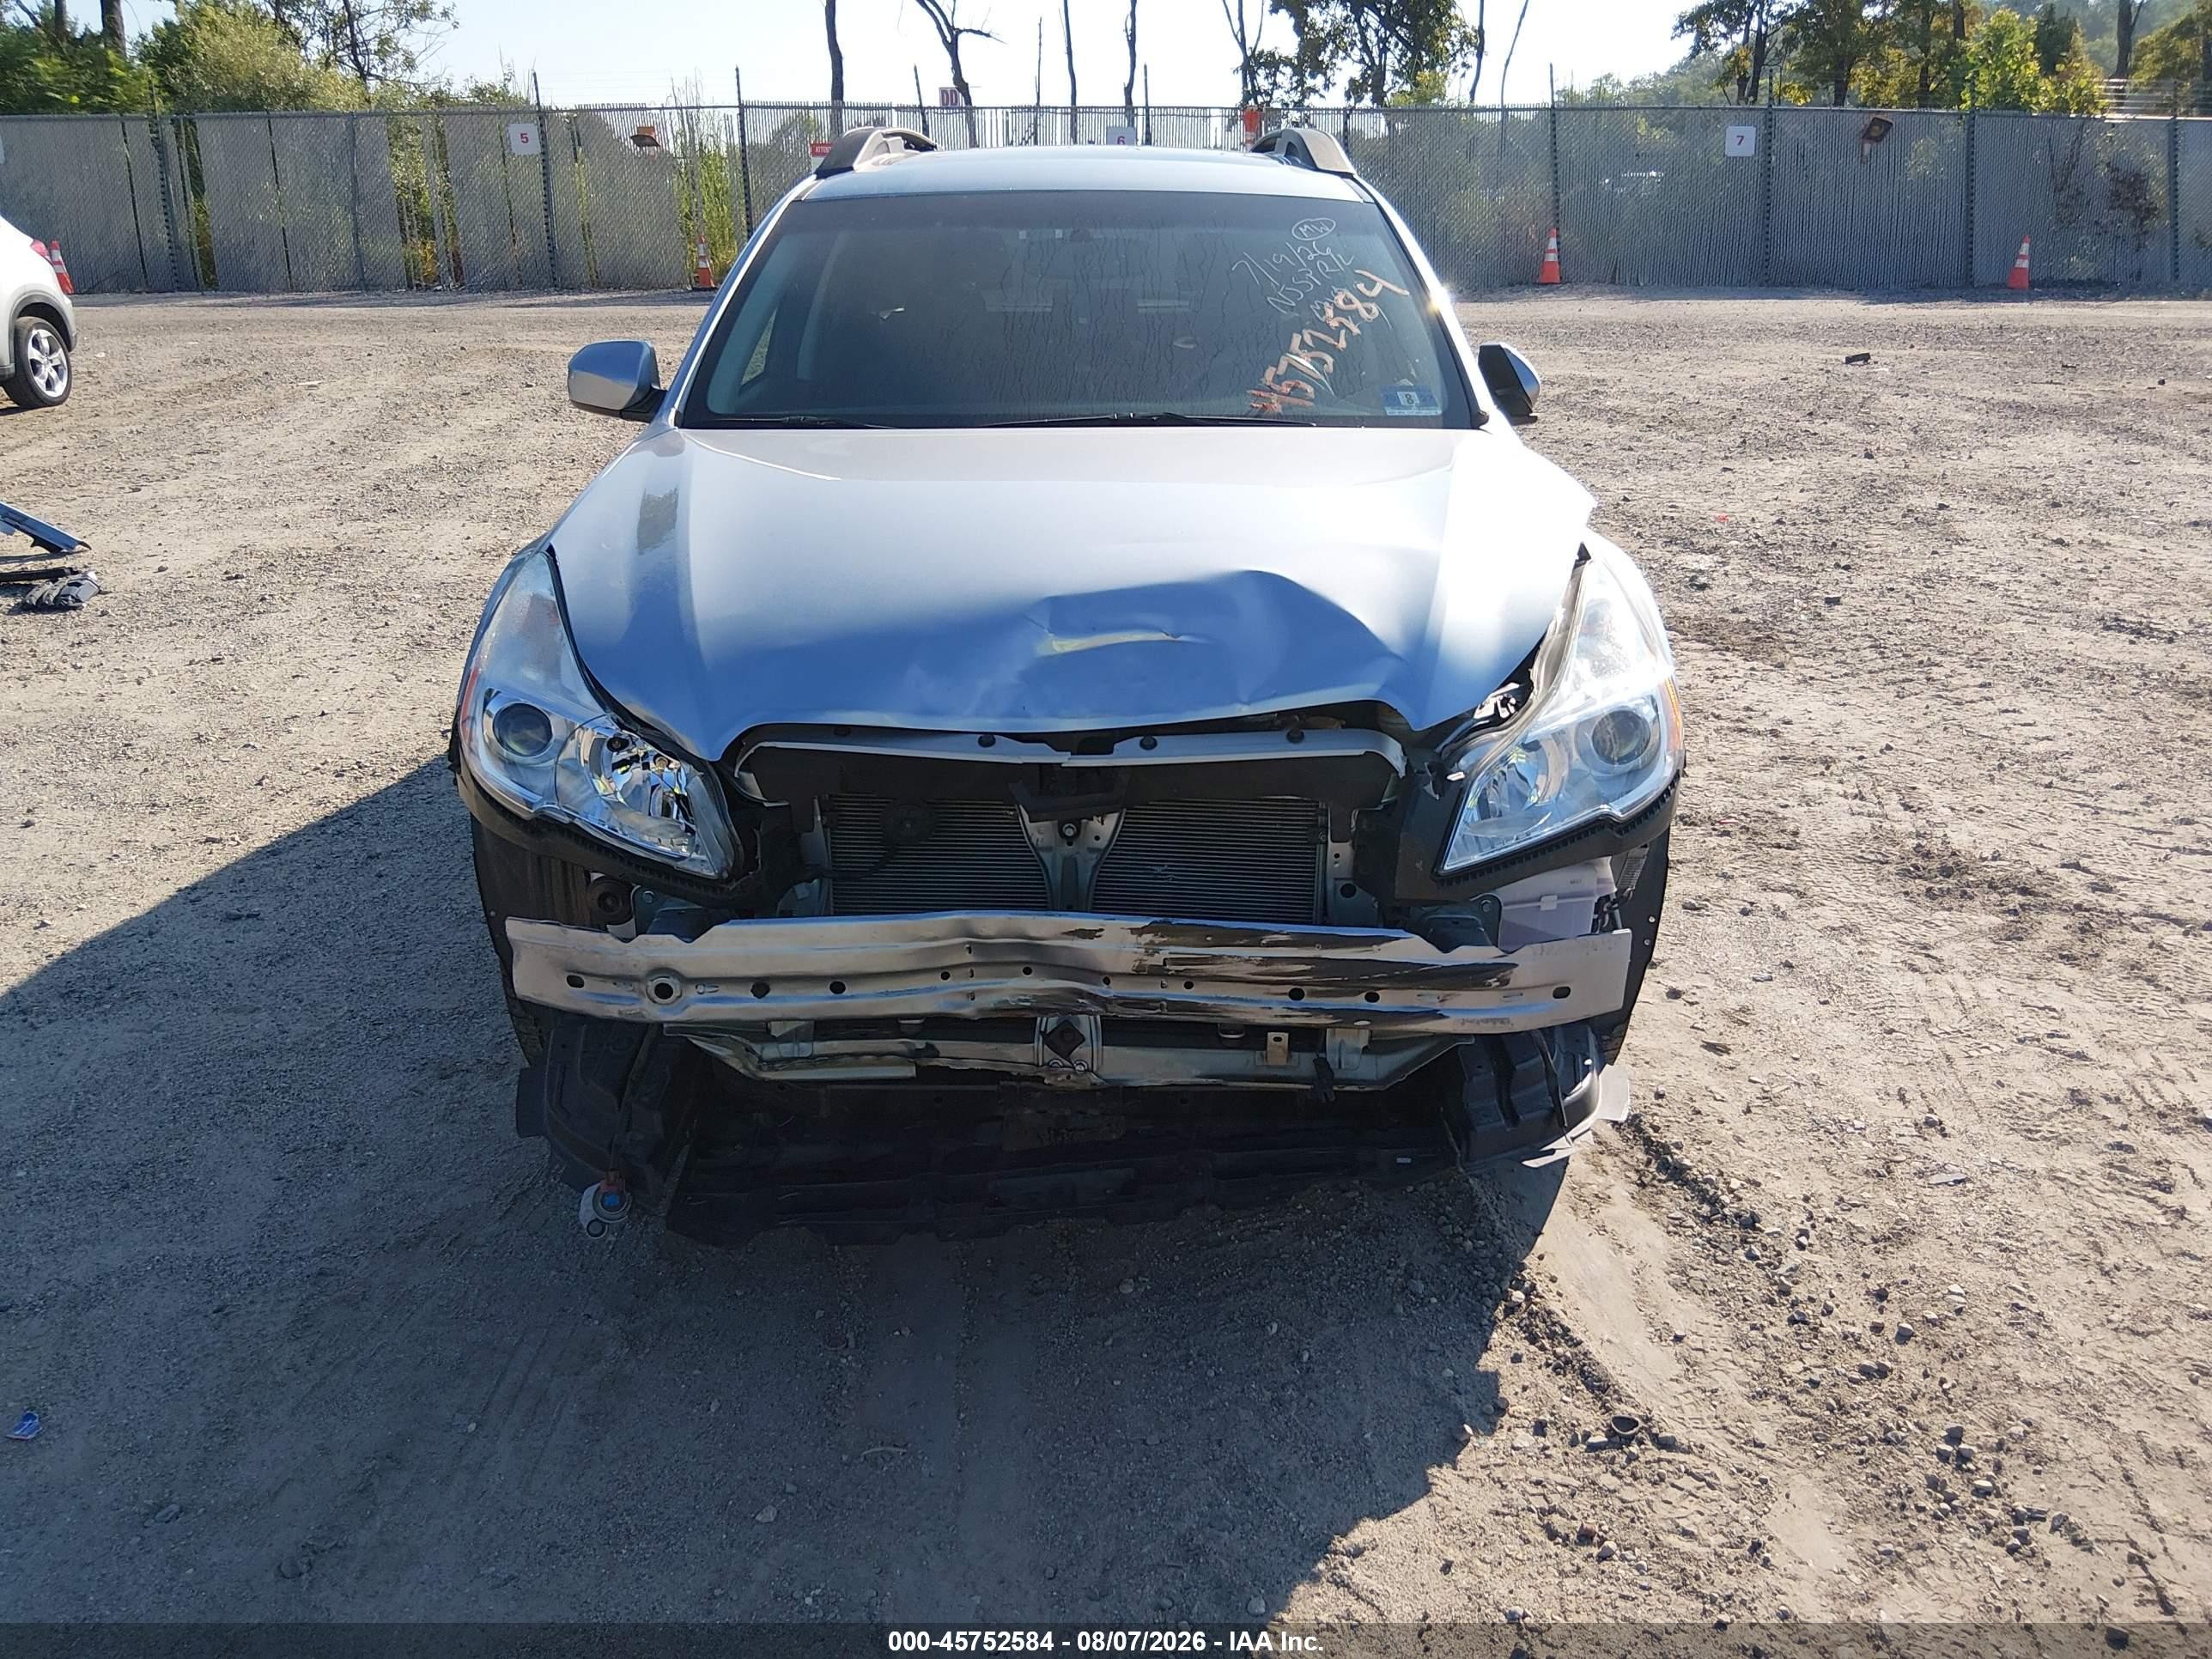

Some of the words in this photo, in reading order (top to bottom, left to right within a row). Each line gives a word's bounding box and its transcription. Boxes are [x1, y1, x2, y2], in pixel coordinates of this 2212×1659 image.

[520, 132, 529, 144] 5
[1117, 136, 1126, 145] 6
[1736, 135, 1745, 146] 7
[1231, 241, 1332, 287] 7/19/26
[1405, 393, 1415, 405] 8
